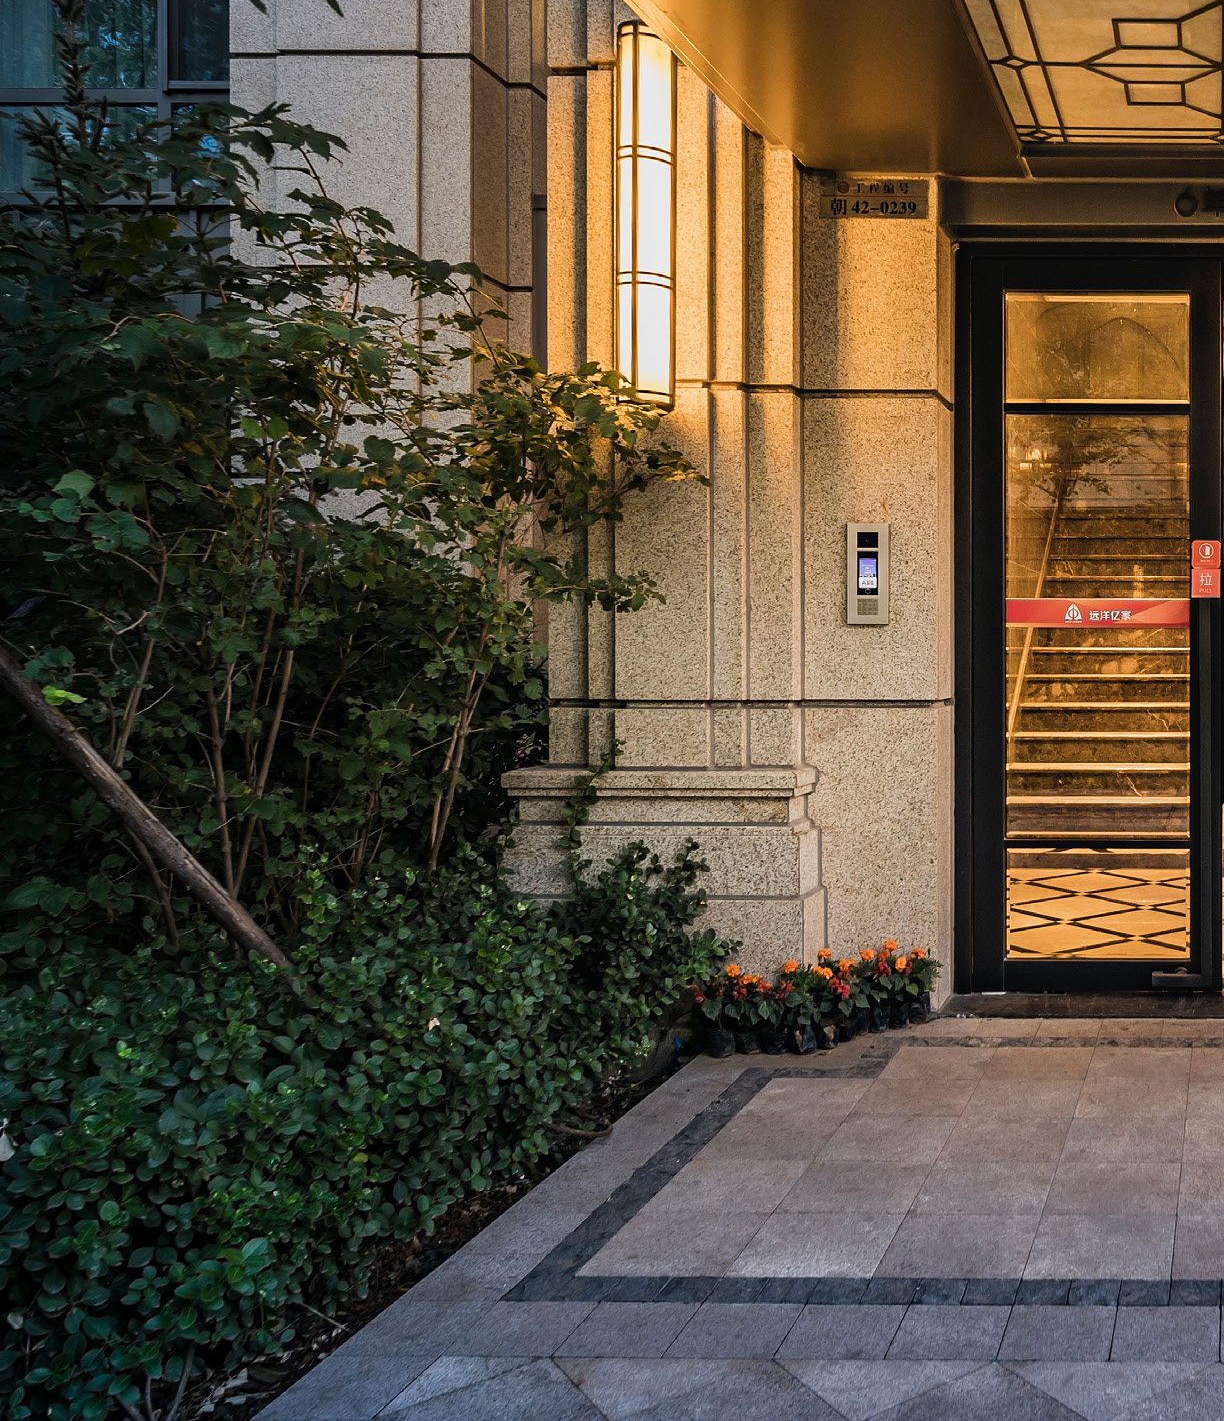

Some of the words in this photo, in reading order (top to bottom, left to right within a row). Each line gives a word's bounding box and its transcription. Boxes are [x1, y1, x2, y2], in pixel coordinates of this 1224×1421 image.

[1200, 573, 1213, 586] 拉
[1089, 610, 1132, 621] 远洋亿家
